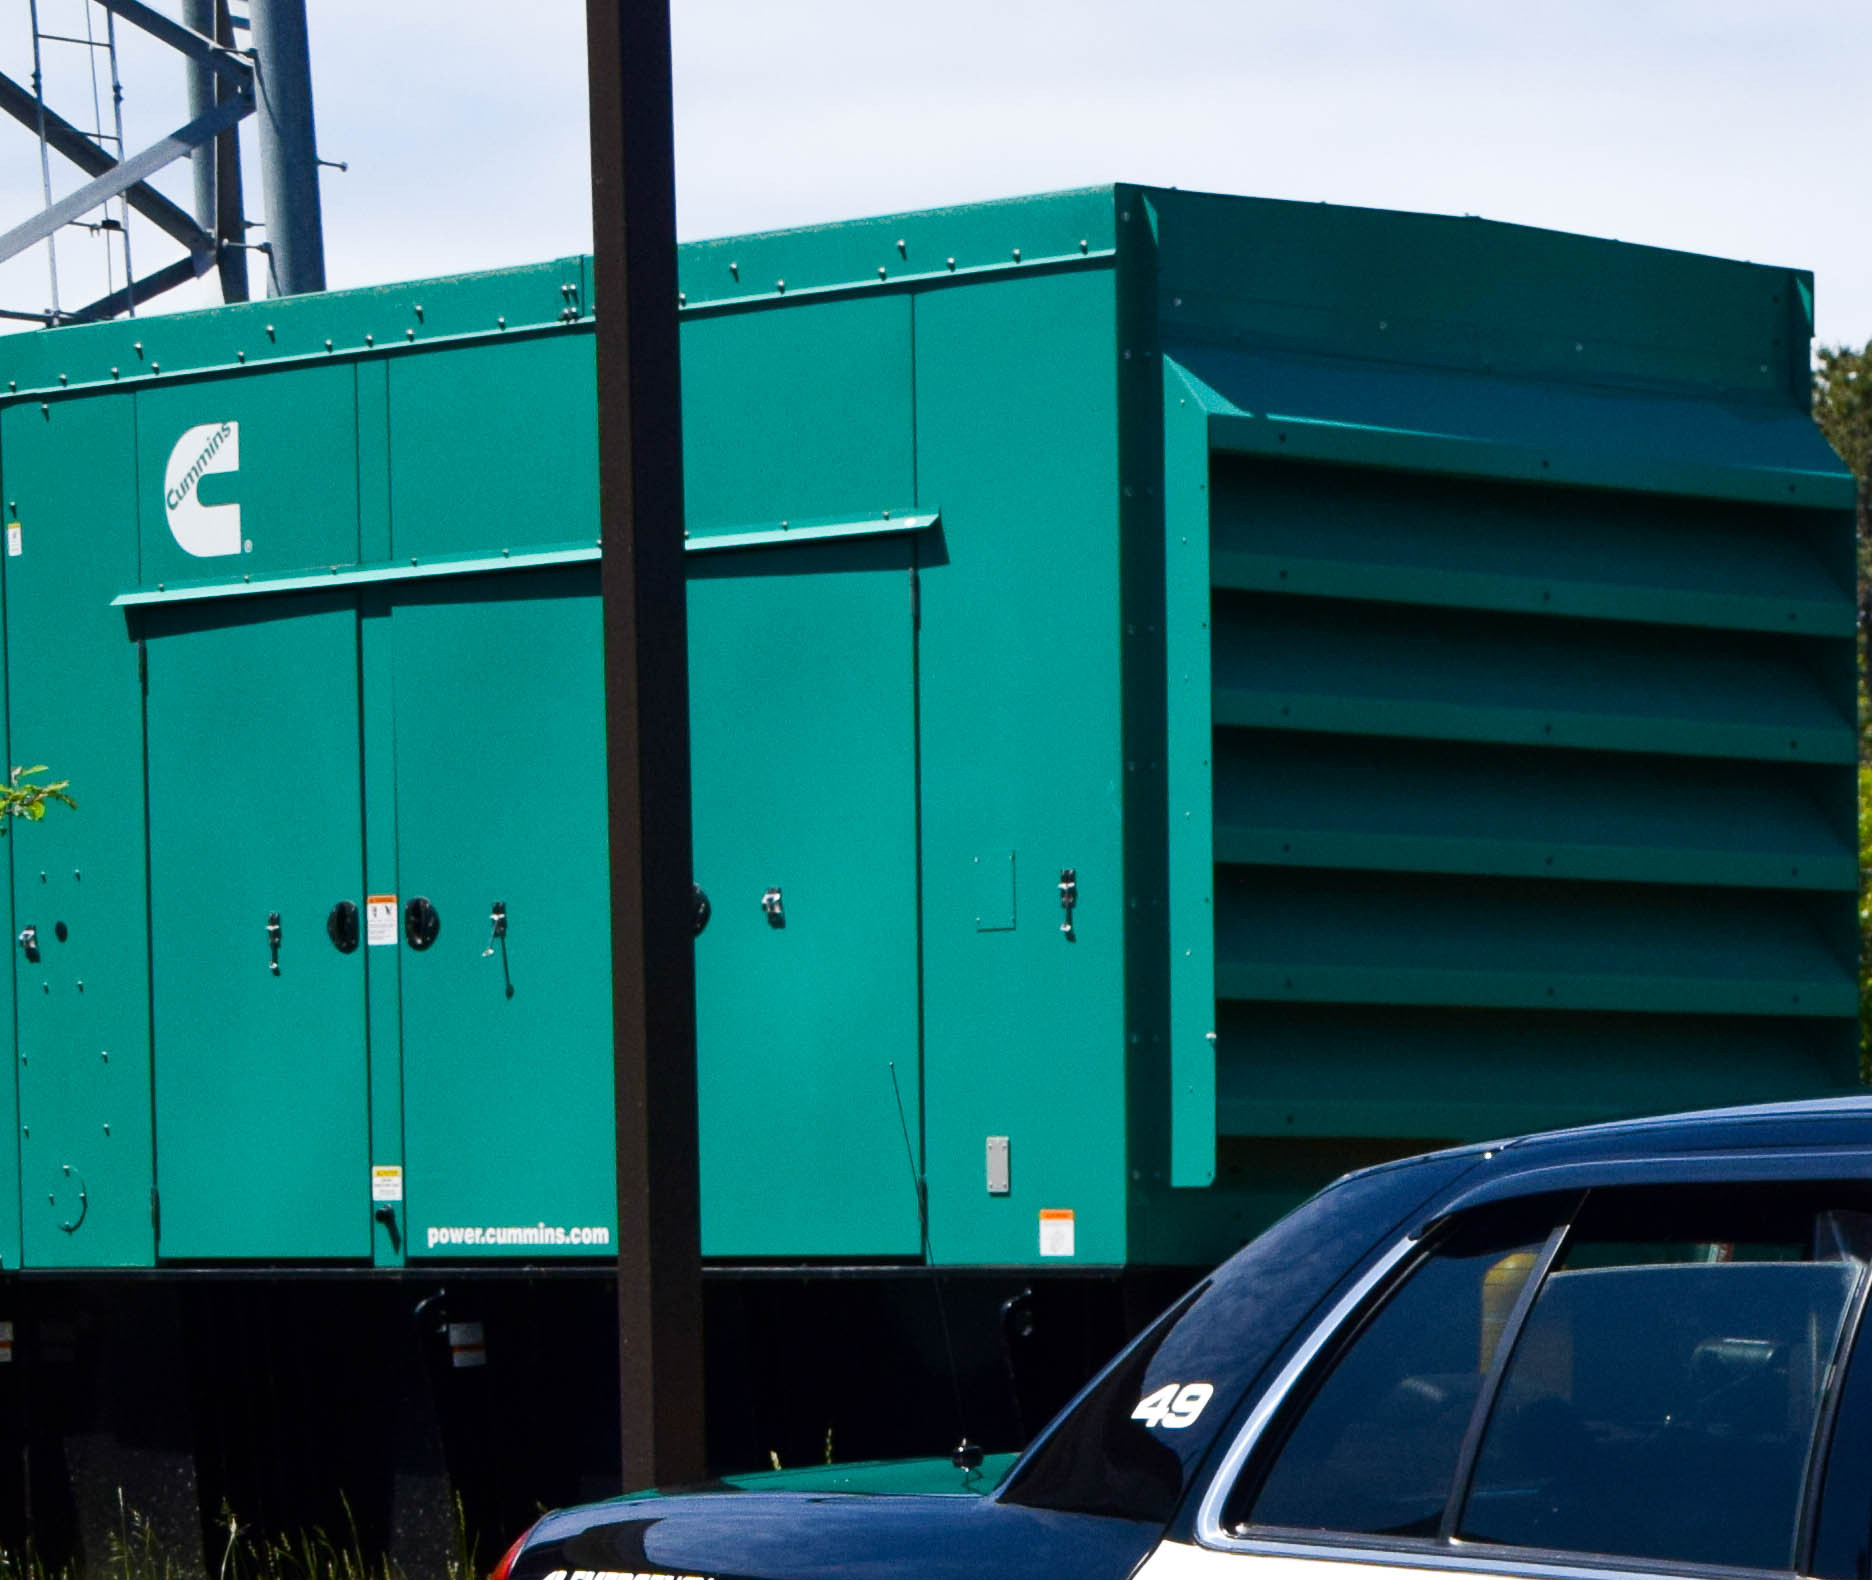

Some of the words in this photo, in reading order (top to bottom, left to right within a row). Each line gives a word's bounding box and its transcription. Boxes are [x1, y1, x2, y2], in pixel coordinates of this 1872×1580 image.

[166, 422, 231, 511] Cummins
[427, 1221, 610, 1249] power.cummins.com
[1130, 1382, 1214, 1429] 49
